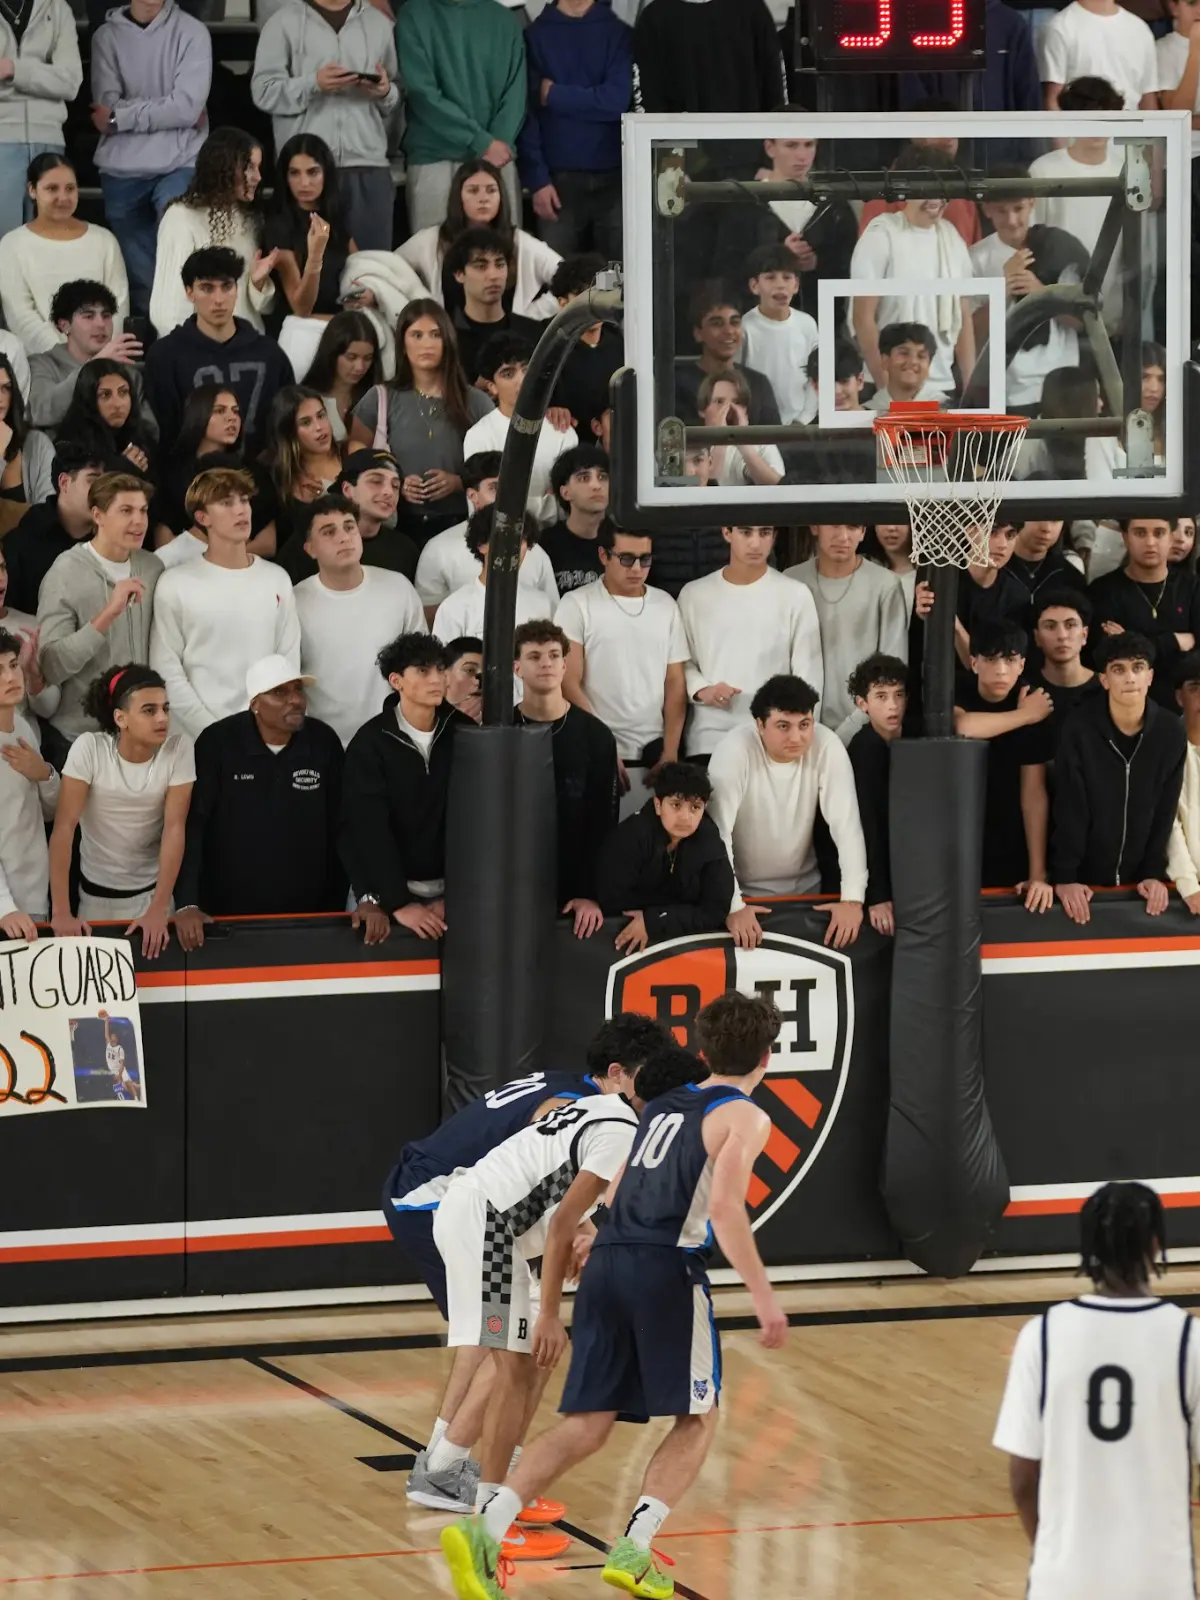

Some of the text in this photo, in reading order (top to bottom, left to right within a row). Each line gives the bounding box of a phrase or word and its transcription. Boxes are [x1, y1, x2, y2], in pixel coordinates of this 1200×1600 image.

[29, 944, 136, 1009] GUARD
[631, 1113, 684, 1169] 10
[1087, 1364, 1133, 1442] 0
